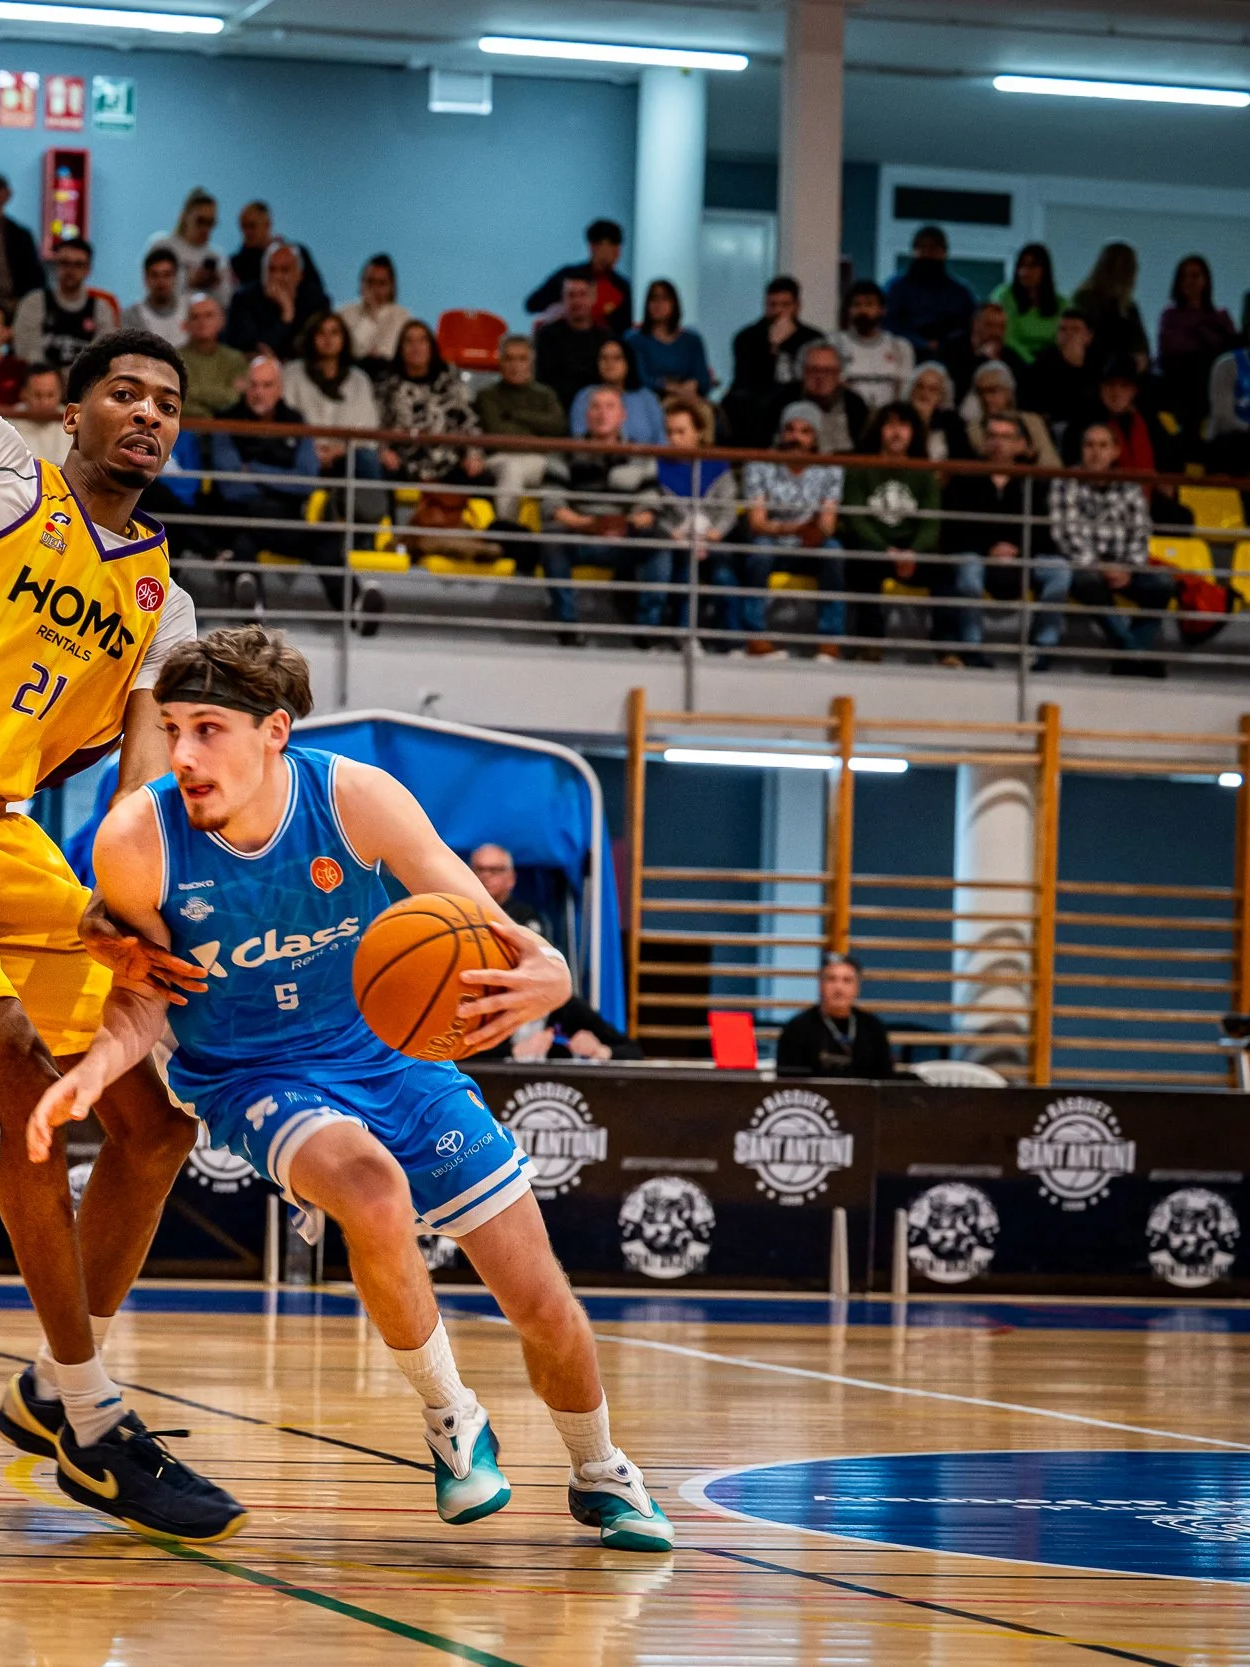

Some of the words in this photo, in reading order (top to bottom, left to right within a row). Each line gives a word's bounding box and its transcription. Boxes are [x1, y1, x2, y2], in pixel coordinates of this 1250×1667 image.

[7, 565, 135, 660] HOMS
[36, 624, 93, 662] RENTALS
[11, 662, 70, 721] 21
[274, 982, 300, 1011] 5
[431, 1155, 464, 1178] EBUSUS
[464, 1132, 495, 1159] MOTOR
